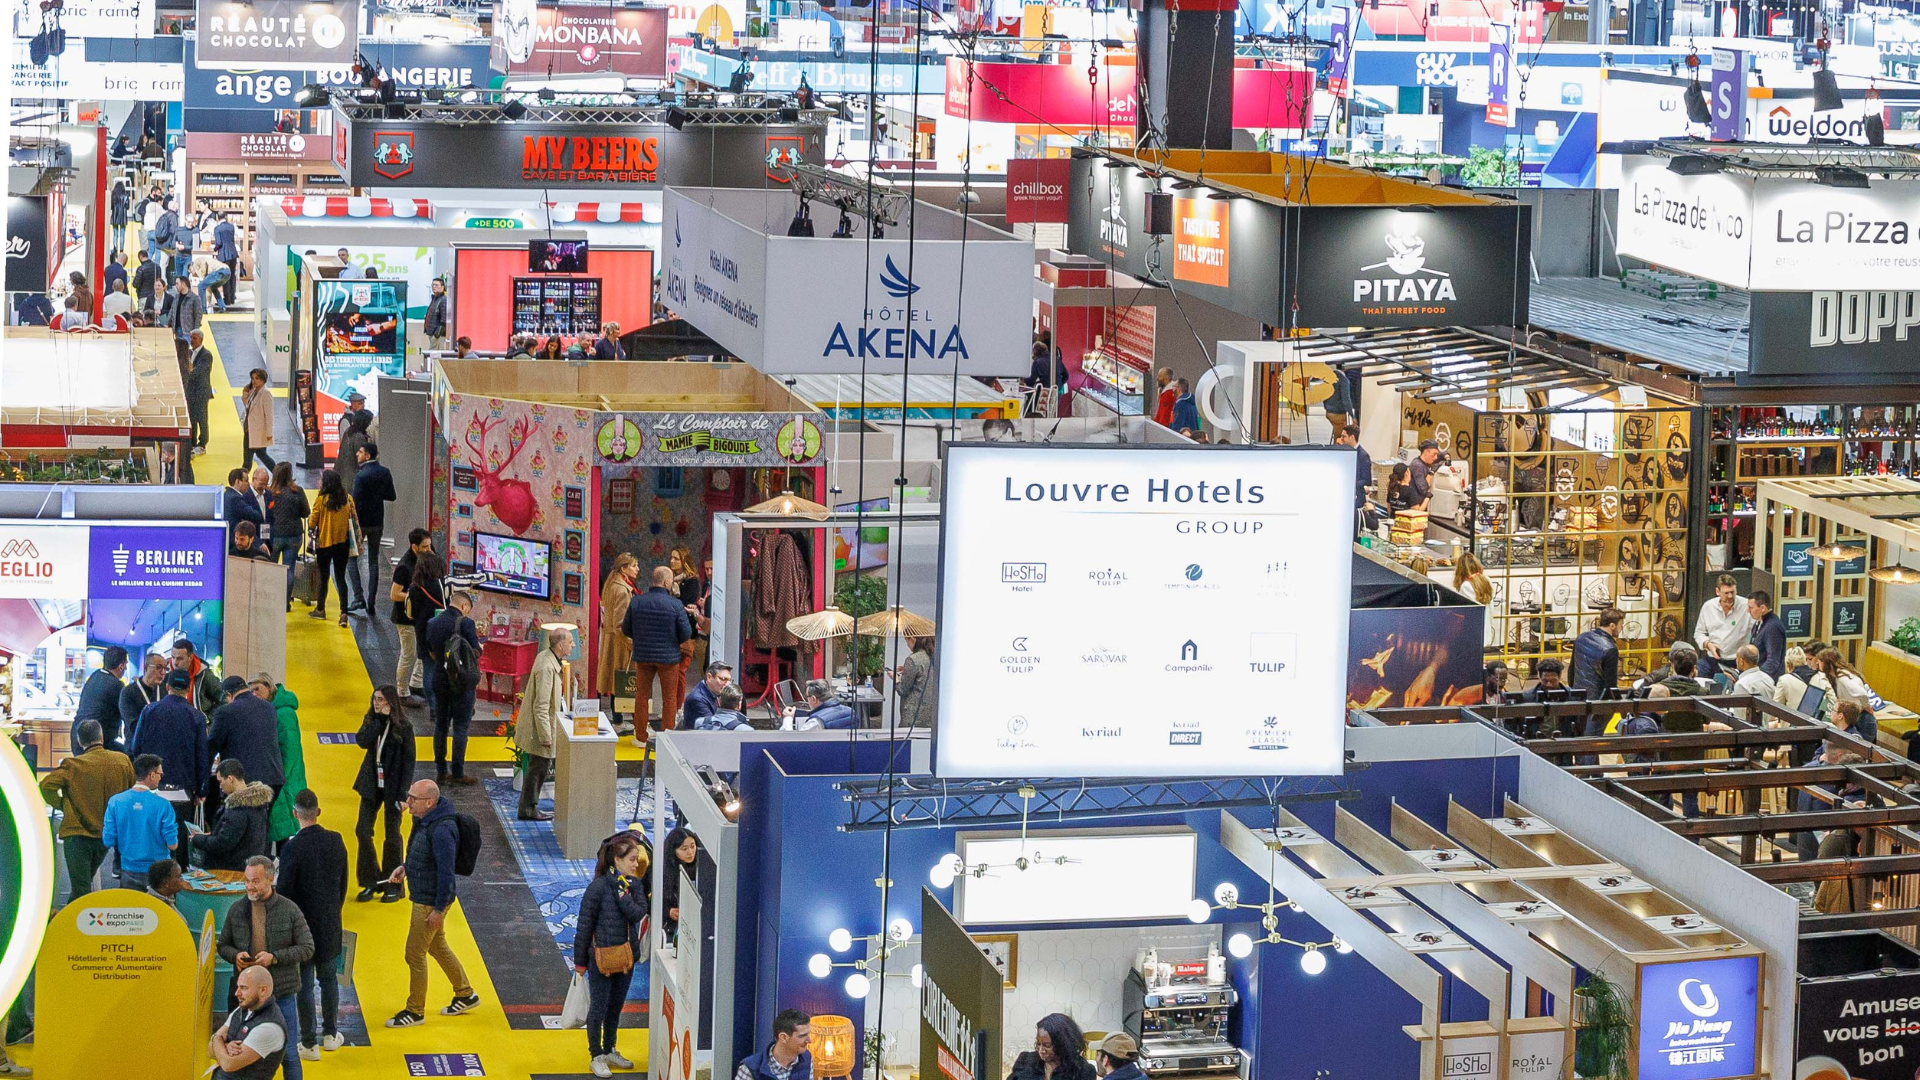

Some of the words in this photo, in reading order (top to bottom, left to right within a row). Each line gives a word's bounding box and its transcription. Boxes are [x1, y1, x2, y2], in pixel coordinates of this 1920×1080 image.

[211, 13, 306, 33] RÉAUTÉ
[562, 16, 617, 26] CHOCOLATERIE
[211, 35, 306, 48] CHOCOLAT
[535, 25, 642, 45] MONBANA
[1416, 53, 1456, 69] GUY
[1493, 53, 1504, 86] R
[215, 74, 292, 103] ange
[1718, 81, 1732, 119] S
[522, 136, 566, 170] MY
[571, 136, 659, 171] BEERS
[522, 171, 555, 180] CAVE
[558, 172, 574, 180] ET
[577, 171, 604, 180] BAR
[618, 171, 657, 182] BIÈRE
[1013, 182, 1063, 194] chillbox
[1690, 195, 1707, 231] de
[493, 219, 514, 228] 500
[1777, 209, 1814, 243] La
[1825, 210, 1909, 244] Pizza
[1100, 219, 1128, 248] PITAYA
[1197, 246, 1225, 267] SPIRIT
[1353, 278, 1456, 302] PITAYA
[863, 305, 932, 321] HÔTEL
[1362, 306, 1384, 314] THAÏ
[1386, 306, 1419, 314] STREET
[1421, 306, 1446, 314] FOOD
[822, 321, 969, 359] AKENA
[653, 414, 675, 430] Le
[680, 414, 748, 433] Comptoir
[752, 415, 769, 430] de
[665, 434, 693, 450] MAMIE
[713, 439, 750, 453] BIGOUDE
[1005, 476, 1130, 502] Louvre
[1147, 478, 1265, 504] Hotels
[1176, 520, 1264, 534] GROUP
[136, 550, 203, 566] BERLINER
[1088, 568, 1128, 580] ROYAL
[1000, 656, 1041, 664] GOLDEN
[1081, 654, 1127, 664] SAROVAR
[1006, 665, 1034, 674] TULIP
[1164, 663, 1213, 673] Campanile
[1249, 662, 1286, 673] TULIP
[1171, 733, 1201, 744] DIRECT
[101, 944, 134, 952] PITCH
[1823, 1024, 1879, 1043] vous
[1512, 1055, 1553, 1068] ROYAL
[1858, 1044, 1904, 1066] bon
